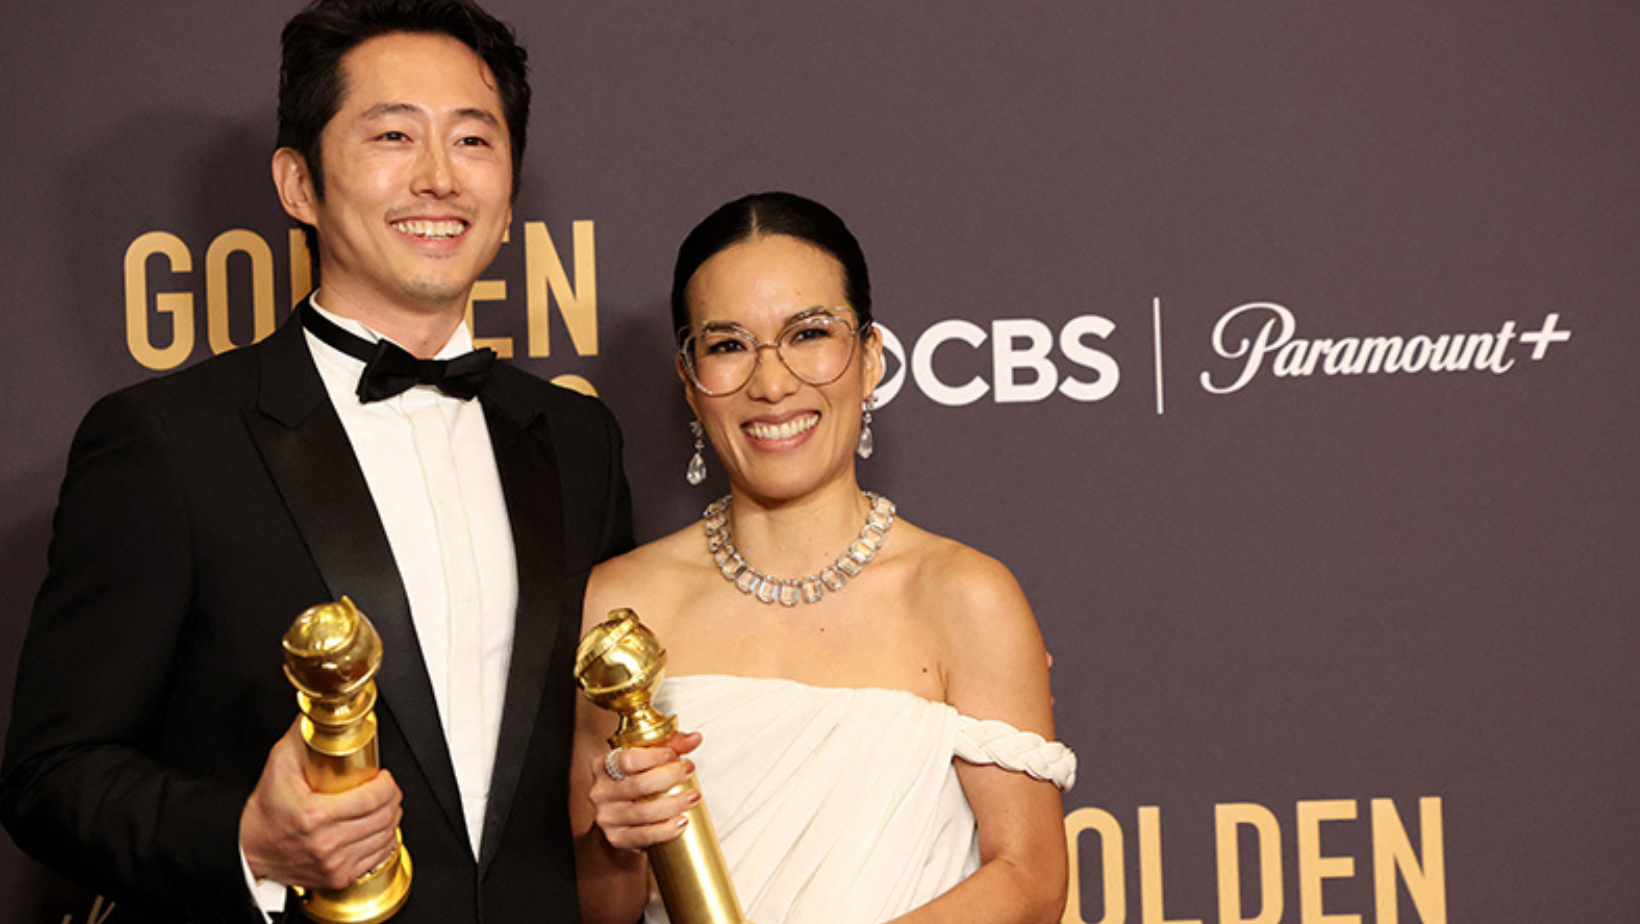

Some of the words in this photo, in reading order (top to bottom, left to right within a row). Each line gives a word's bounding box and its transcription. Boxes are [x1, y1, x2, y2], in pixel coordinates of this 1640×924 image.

[123, 219, 600, 371] GOEN
[1200, 302, 1571, 394] Paramount+
[911, 315, 1120, 405] CBS
[1061, 796, 1448, 924] OLDEN
